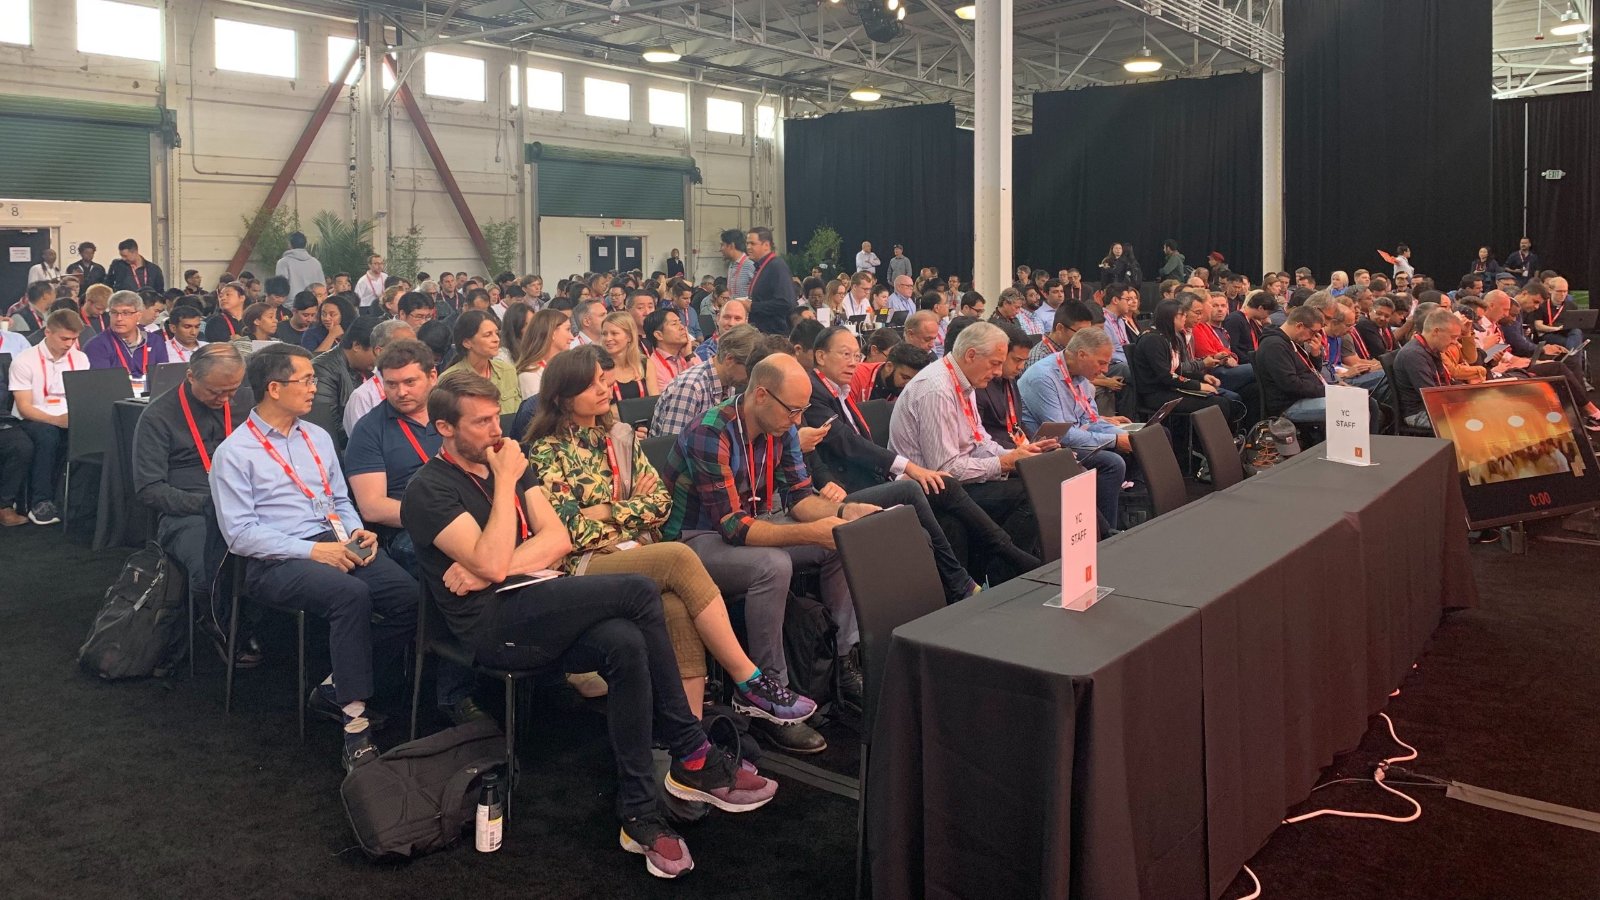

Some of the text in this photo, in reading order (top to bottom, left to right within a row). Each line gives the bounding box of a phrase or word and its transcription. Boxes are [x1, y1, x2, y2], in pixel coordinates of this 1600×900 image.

[1548, 170, 1560, 178] EXIT
[11, 206, 19, 217] 8
[69, 245, 77, 255] 8
[1340, 409, 1350, 417] YC
[1335, 420, 1356, 429] STAFF
[1530, 492, 1551, 506] 0:00
[1075, 513, 1082, 524] YC
[1071, 529, 1087, 545] STAFF
